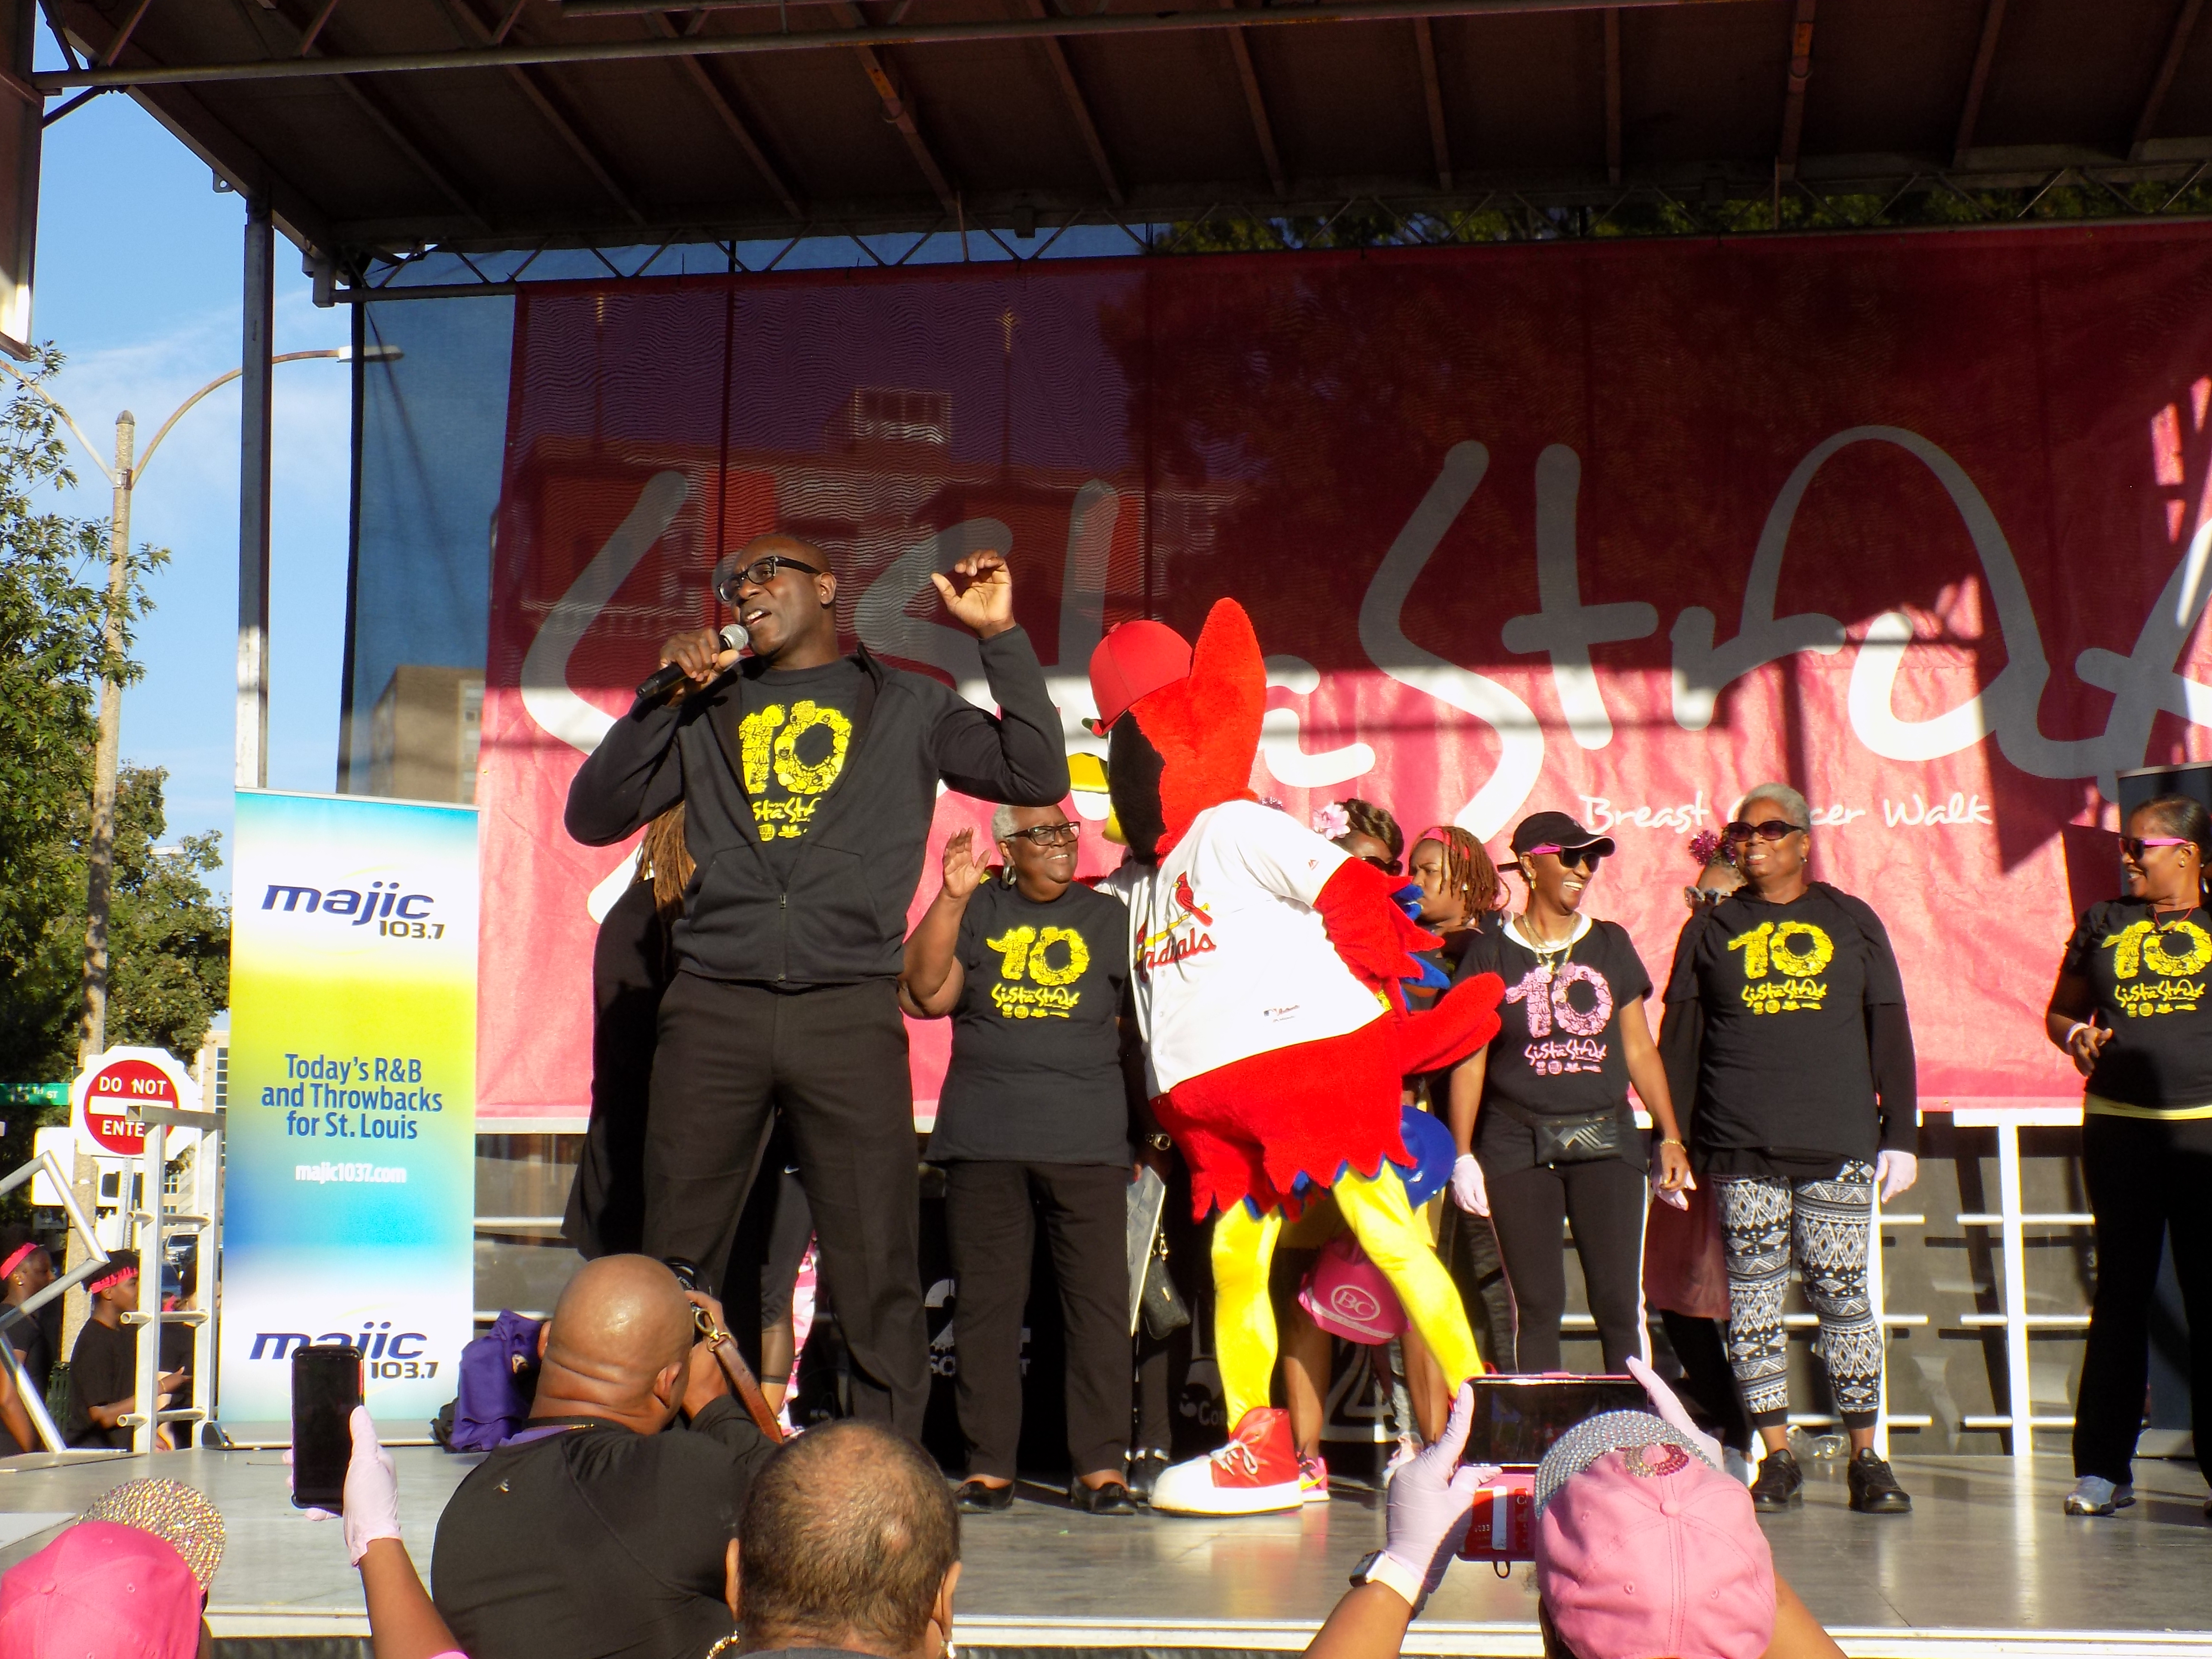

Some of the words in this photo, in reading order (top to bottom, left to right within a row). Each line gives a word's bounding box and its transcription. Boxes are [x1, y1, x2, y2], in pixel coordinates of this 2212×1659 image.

[738, 699, 852, 795] 10
[1579, 790, 1709, 834] Breast
[1883, 792, 1993, 828] Walk
[261, 881, 434, 926] majic
[379, 920, 445, 939] 103.7
[986, 926, 1091, 986] 10
[1728, 921, 1835, 979] 10
[1506, 962, 1613, 1039] 10
[284, 1053, 369, 1085] Today's
[374, 1057, 422, 1083] R&B
[46, 1091, 58, 1099] ST
[98, 1076, 122, 1092] DO
[131, 1078, 167, 1095] NOT
[261, 1082, 304, 1108] and
[309, 1082, 443, 1112] Throwbacks
[101, 1119, 145, 1138] ENTE
[286, 1110, 320, 1136] for
[325, 1112, 356, 1138] St.
[360, 1113, 418, 1140] Louis
[295, 1162, 407, 1185] majic1037.com
[370, 1361, 439, 1379] 103.7
